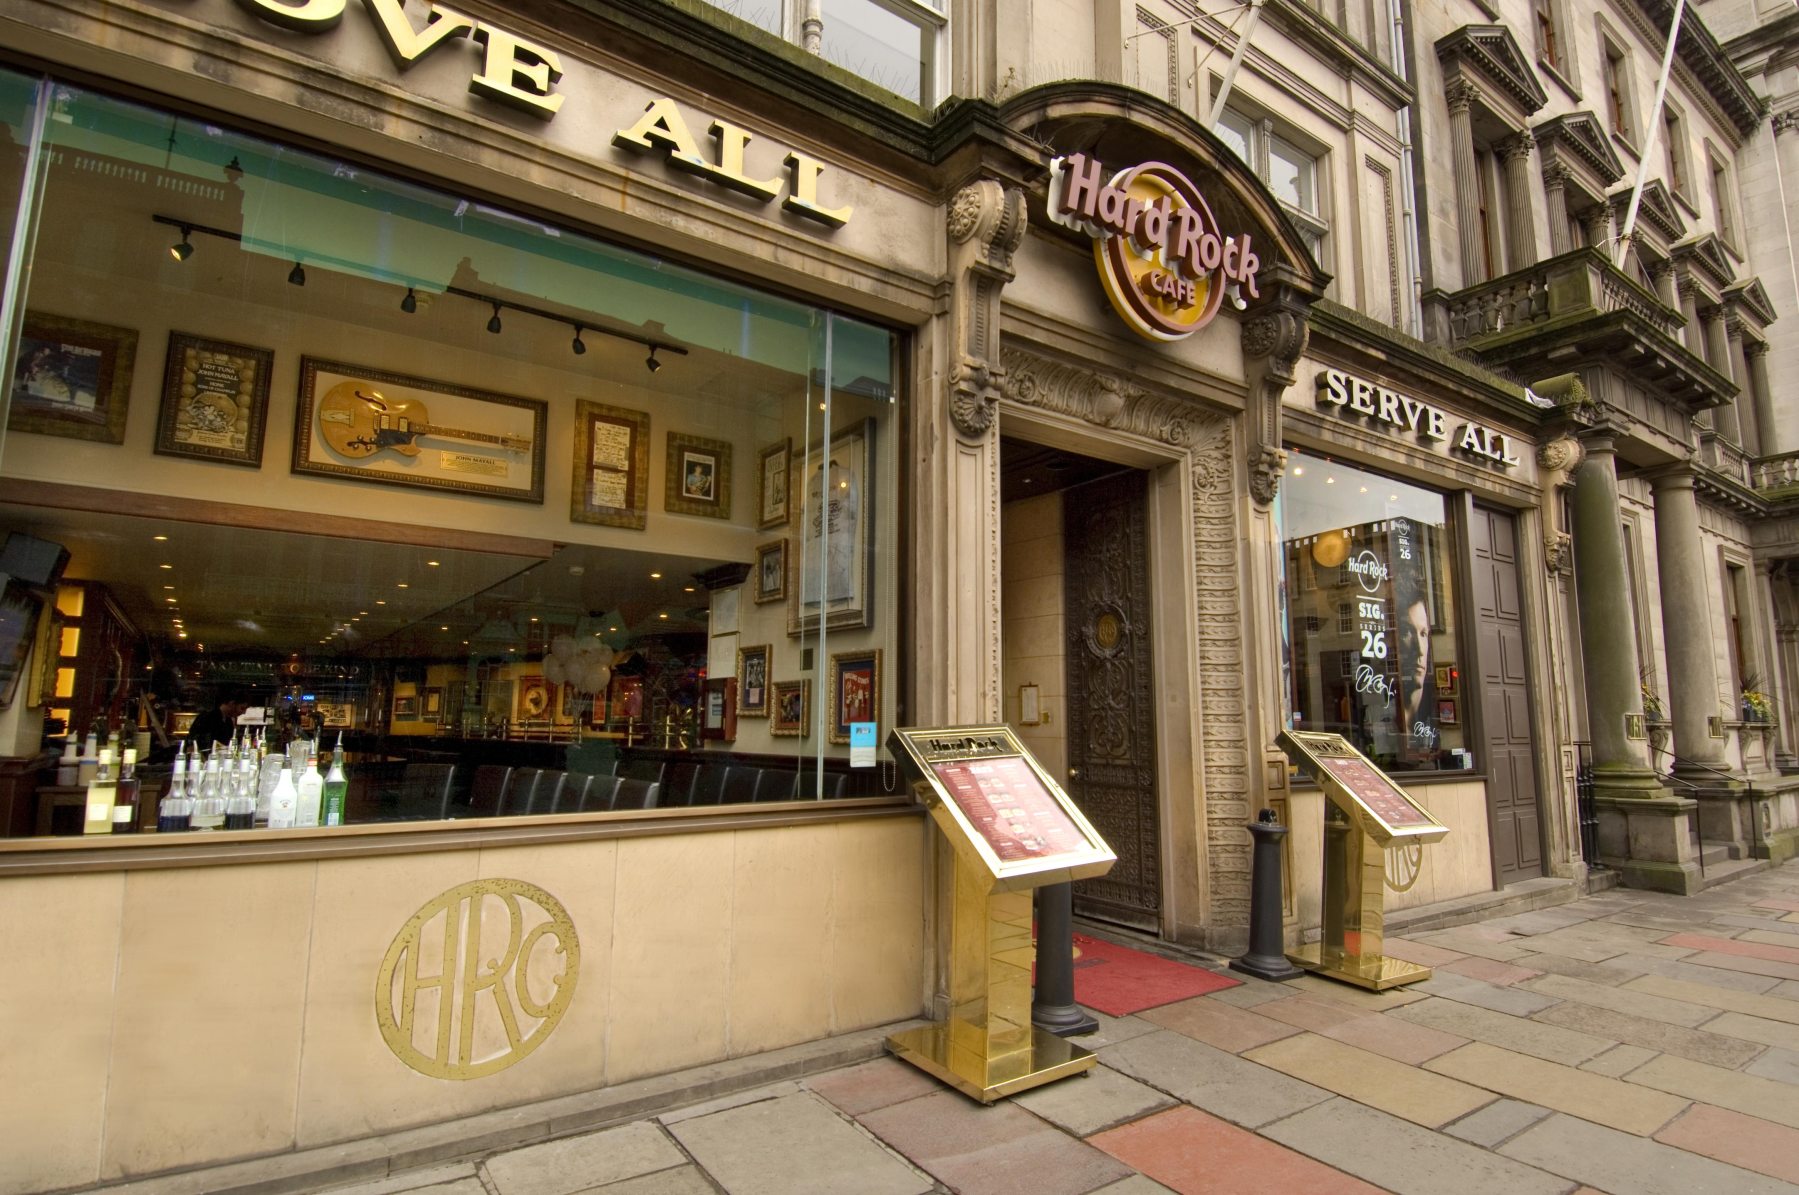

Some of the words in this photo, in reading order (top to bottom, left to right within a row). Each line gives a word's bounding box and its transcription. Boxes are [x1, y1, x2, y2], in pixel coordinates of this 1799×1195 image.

[611, 97, 854, 230] ALL
[1057, 153, 1172, 251] Hard
[1168, 206, 1260, 299] Rock
[1143, 270, 1196, 308] CAFE
[1319, 368, 1447, 441] SERVE
[1455, 422, 1520, 467] ALL
[1348, 557, 1368, 574] Hard
[1368, 560, 1388, 581] Rock
[1399, 549, 1411, 560] 26
[1358, 602, 1385, 620] SIG.
[1361, 630, 1387, 659] 26
[930, 738, 965, 752] Hard
[383, 884, 573, 1072] HRC
